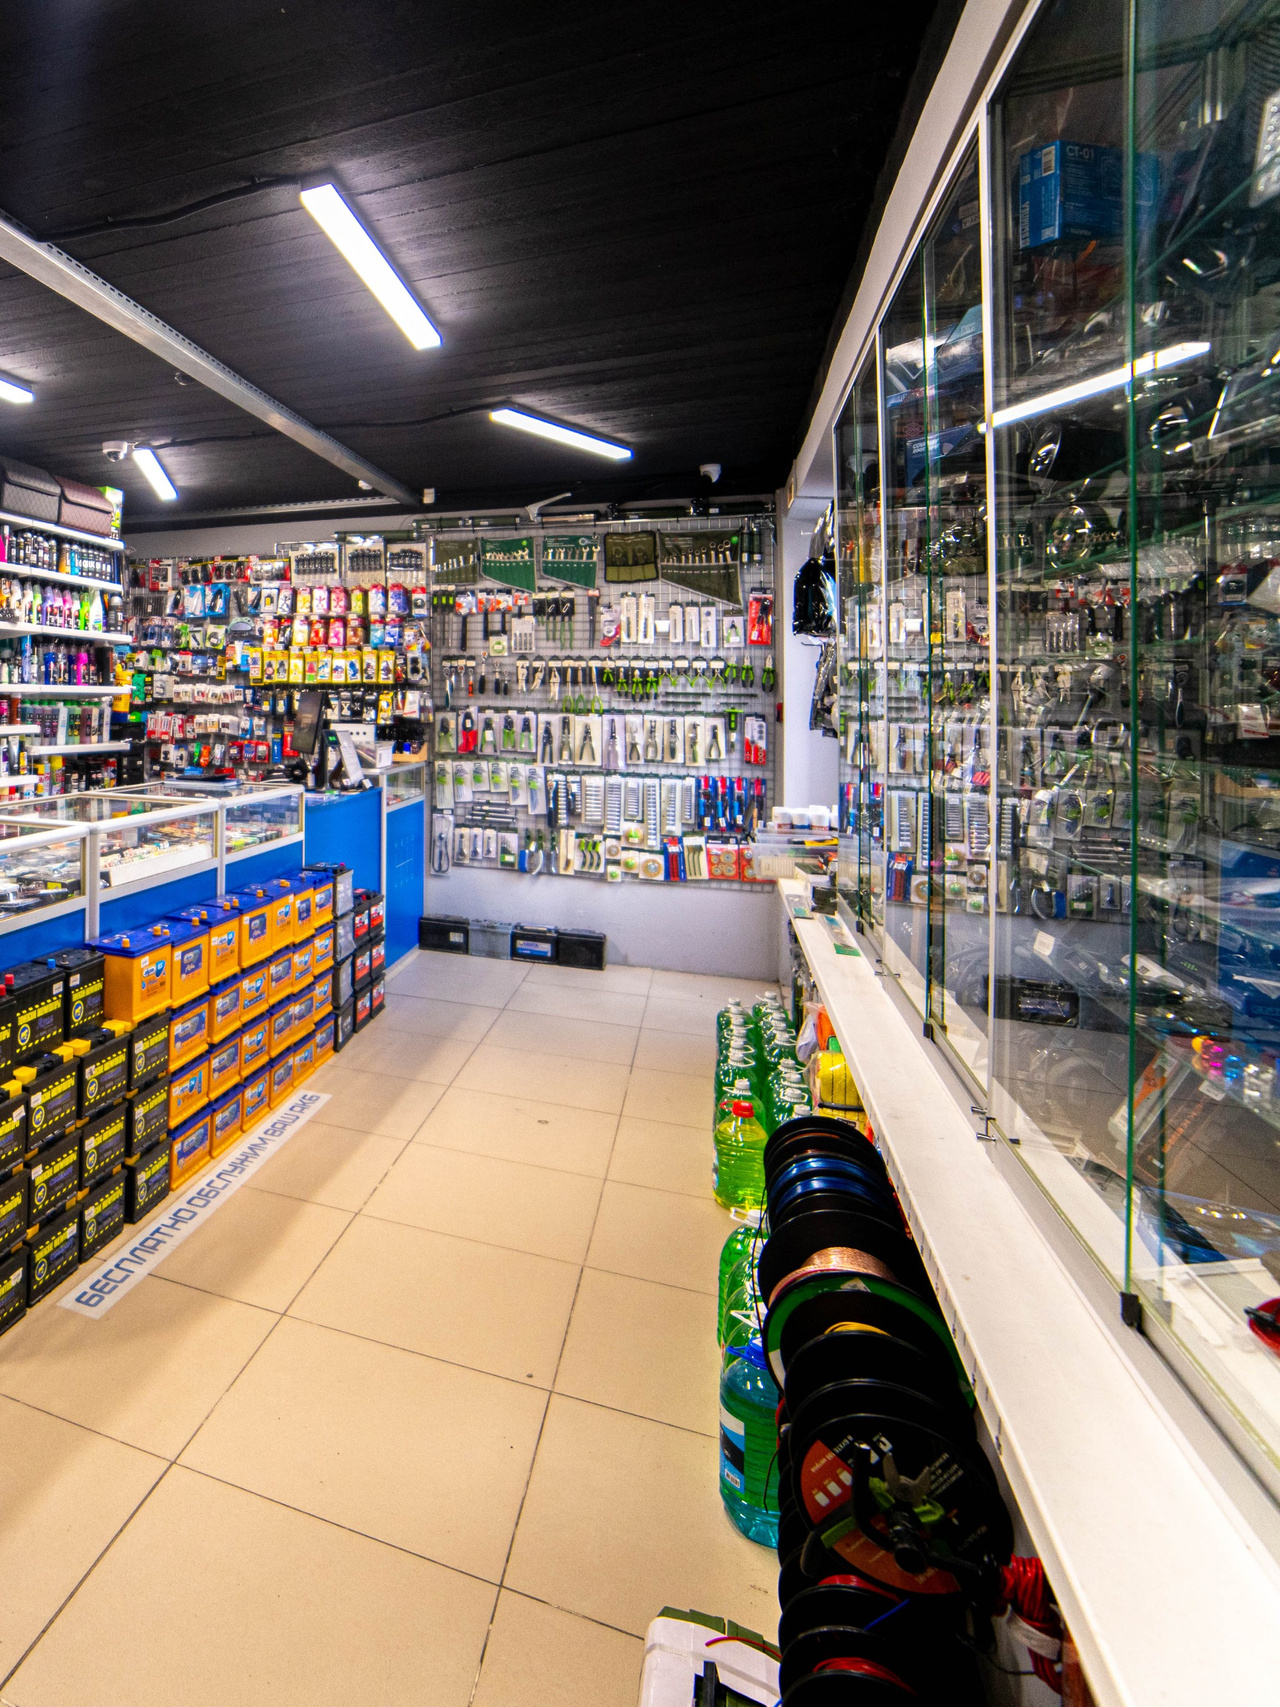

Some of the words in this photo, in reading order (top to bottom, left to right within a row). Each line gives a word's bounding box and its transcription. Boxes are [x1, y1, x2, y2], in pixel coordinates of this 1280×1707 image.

[1066, 146, 1095, 159] CT-01
[75, 1207, 198, 1308] БЕСПЛАТНО
[187, 1137, 275, 1209] ОБСЛУЖИМ
[264, 1105, 300, 1138] ВАШ
[293, 1094, 321, 1115] АКБ
